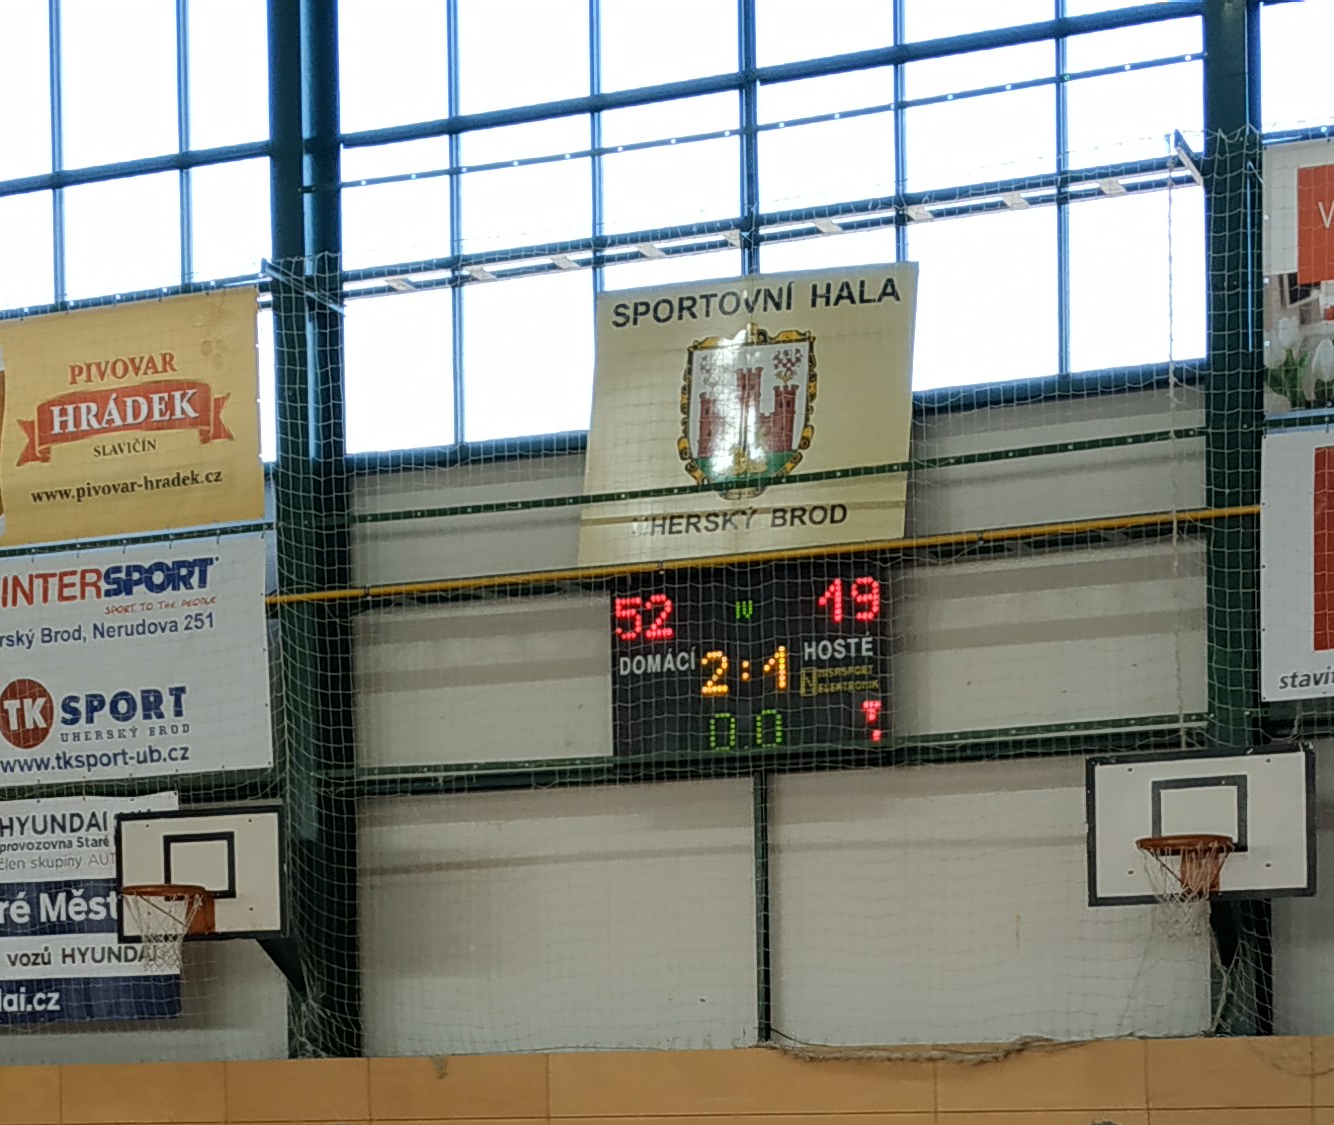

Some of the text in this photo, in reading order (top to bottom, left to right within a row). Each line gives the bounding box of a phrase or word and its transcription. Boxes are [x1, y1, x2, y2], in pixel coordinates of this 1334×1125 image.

[612, 277, 901, 328] SPORTOVNÍ HALA
[68, 352, 178, 385] PIVOVAR
[50, 388, 199, 435] HRÁDEK
[93, 438, 157, 458] SLAVIČÍN
[30, 468, 224, 504] www.pivovar-hradek.cz
[771, 503, 848, 529] BROD
[1, 557, 215, 609] INTERSPORT
[104, 602, 135, 615] SPORT
[141, 601, 154, 612] TO
[819, 577, 880, 622] 19
[41, 625, 87, 644] Brod,
[92, 617, 179, 640] Nerudova
[183, 612, 215, 631] 251
[616, 594, 673, 640] 52
[619, 646, 696, 676] DOMÁCÍ
[804, 632, 874, 661] HOSTÉ
[3, 686, 187, 732] TK SPORT
[60, 723, 191, 743] UHERSKÝ BROD
[0, 746, 190, 774] www.tksport-ub.cz
[0, 836, 110, 855] provozovna Staré
[30, 853, 82, 871] skupiny
[7, 945, 52, 967] vozů
